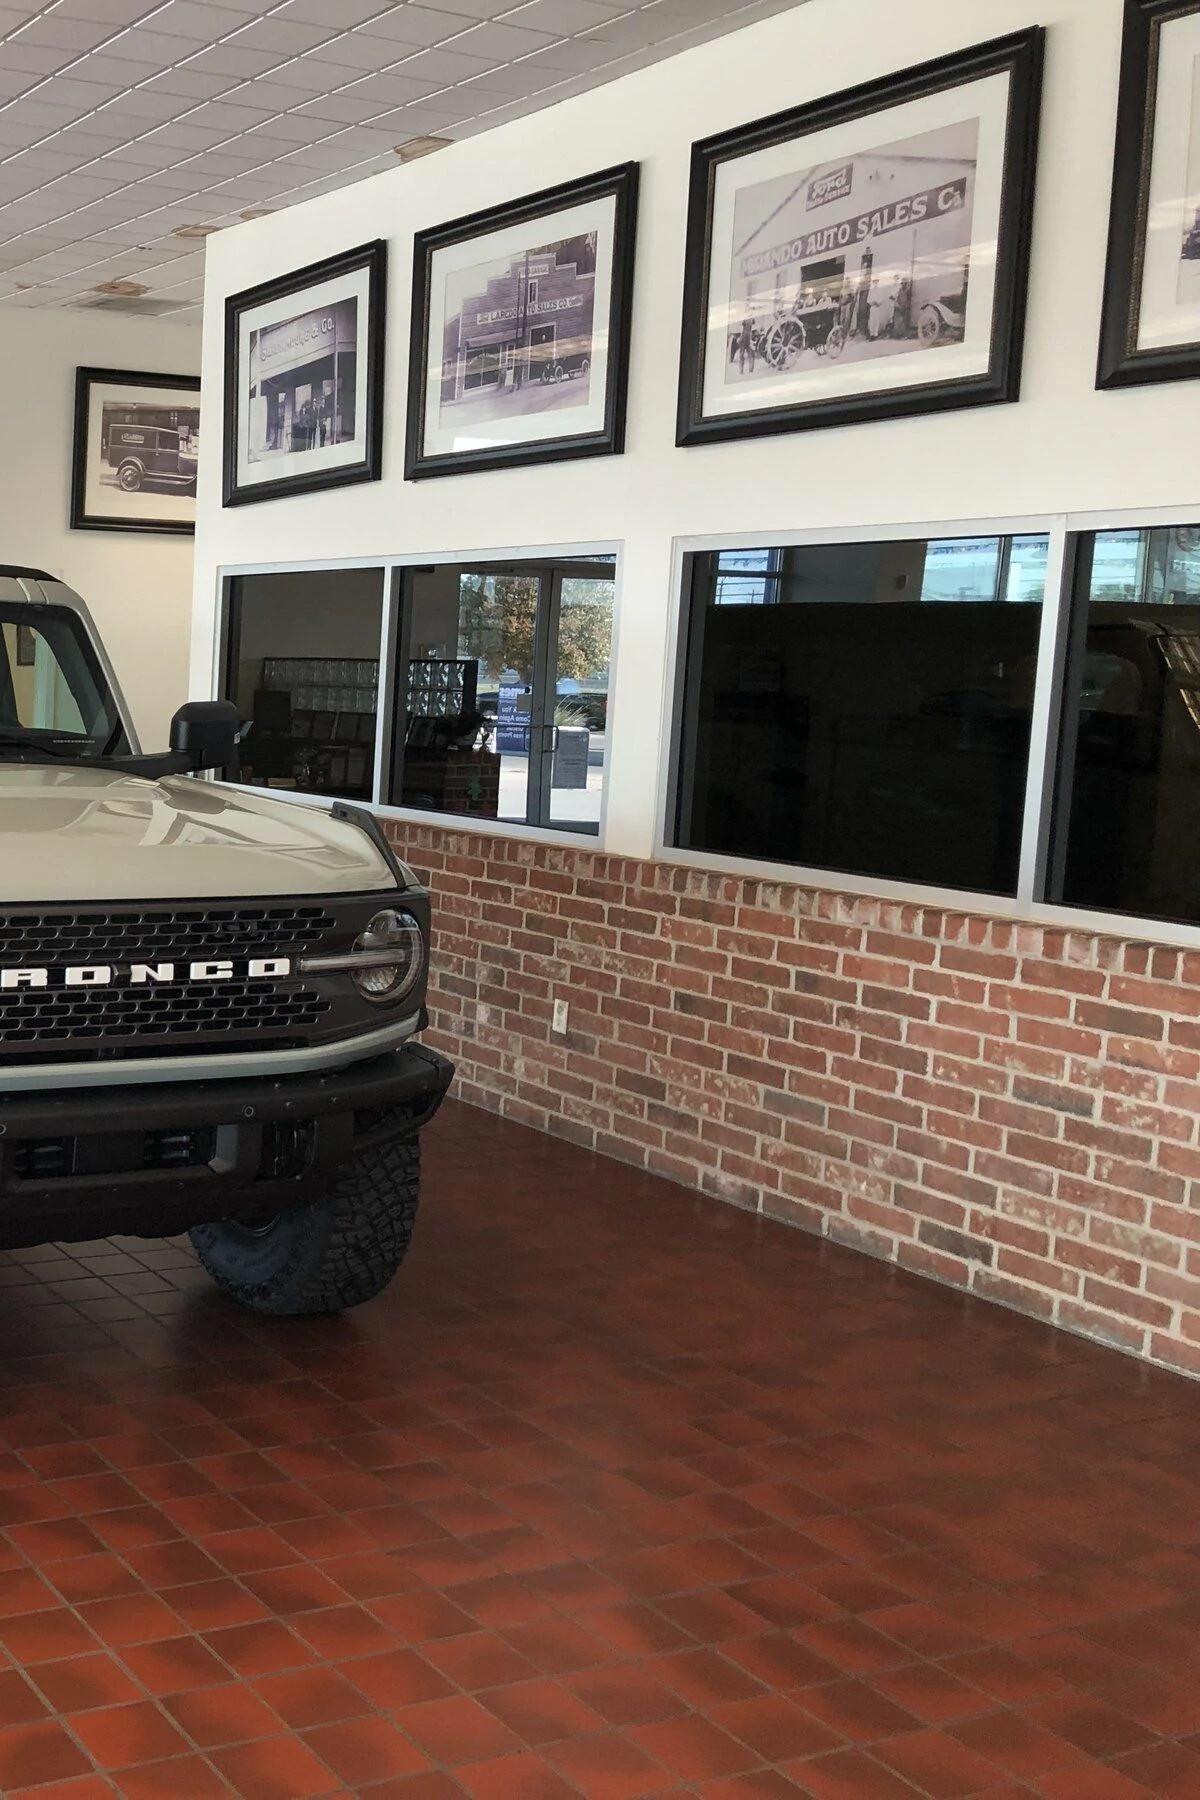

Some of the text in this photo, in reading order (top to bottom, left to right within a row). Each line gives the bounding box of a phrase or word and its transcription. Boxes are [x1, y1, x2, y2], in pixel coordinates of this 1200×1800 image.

[806, 223, 851, 254] AUTO
[856, 195, 928, 239] SALES
[537, 301, 557, 312] SALES
